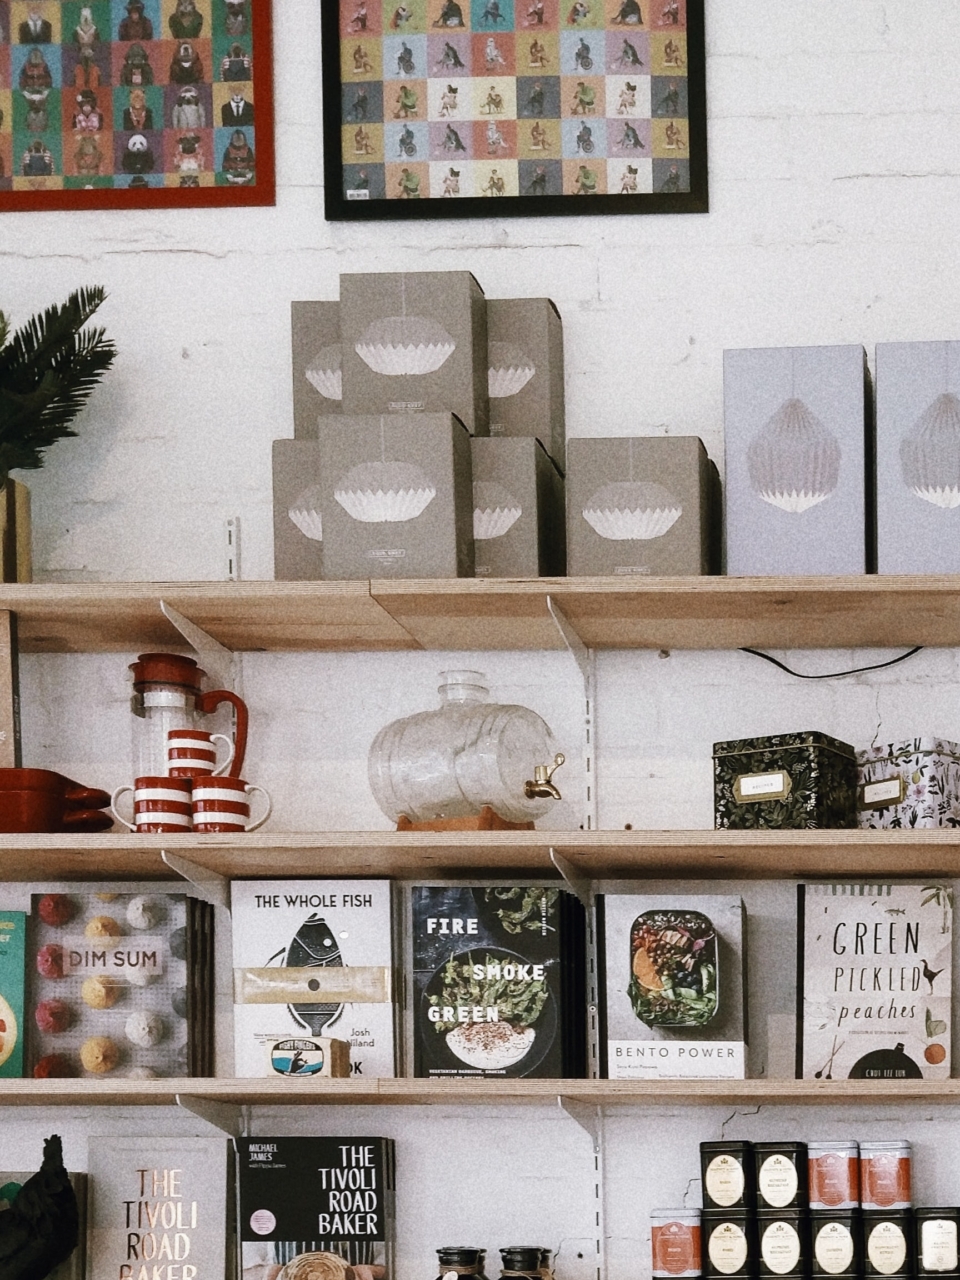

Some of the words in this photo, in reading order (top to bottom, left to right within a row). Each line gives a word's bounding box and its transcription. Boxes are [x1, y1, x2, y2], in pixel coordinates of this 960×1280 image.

[254, 895, 280, 908] THE
[283, 895, 338, 908] WHOLE
[342, 894, 373, 907] FISH
[426, 918, 479, 934] FIRE
[833, 922, 920, 955] GREEN
[69, 951, 107, 967] DIM
[113, 951, 157, 967] SUM
[473, 964, 545, 981] SMOKE
[834, 966, 921, 992] PICKLED
[427, 1006, 499, 1022] GREEN
[838, 998, 916, 1027] peaches
[350, 1028, 371, 1037] Josh
[615, 1047, 669, 1057] BENTO
[678, 1047, 735, 1058] POWER
[249, 1143, 278, 1152] MICHAEL
[249, 1153, 273, 1162] JAMES
[338, 1145, 375, 1167] THE
[136, 1169, 183, 1198] THE
[318, 1168, 376, 1190] TIVOLI
[329, 1191, 377, 1212] ROAD
[122, 1201, 198, 1229] TIVOLI
[318, 1213, 378, 1235] BAKER
[127, 1233, 191, 1260] ROAD
